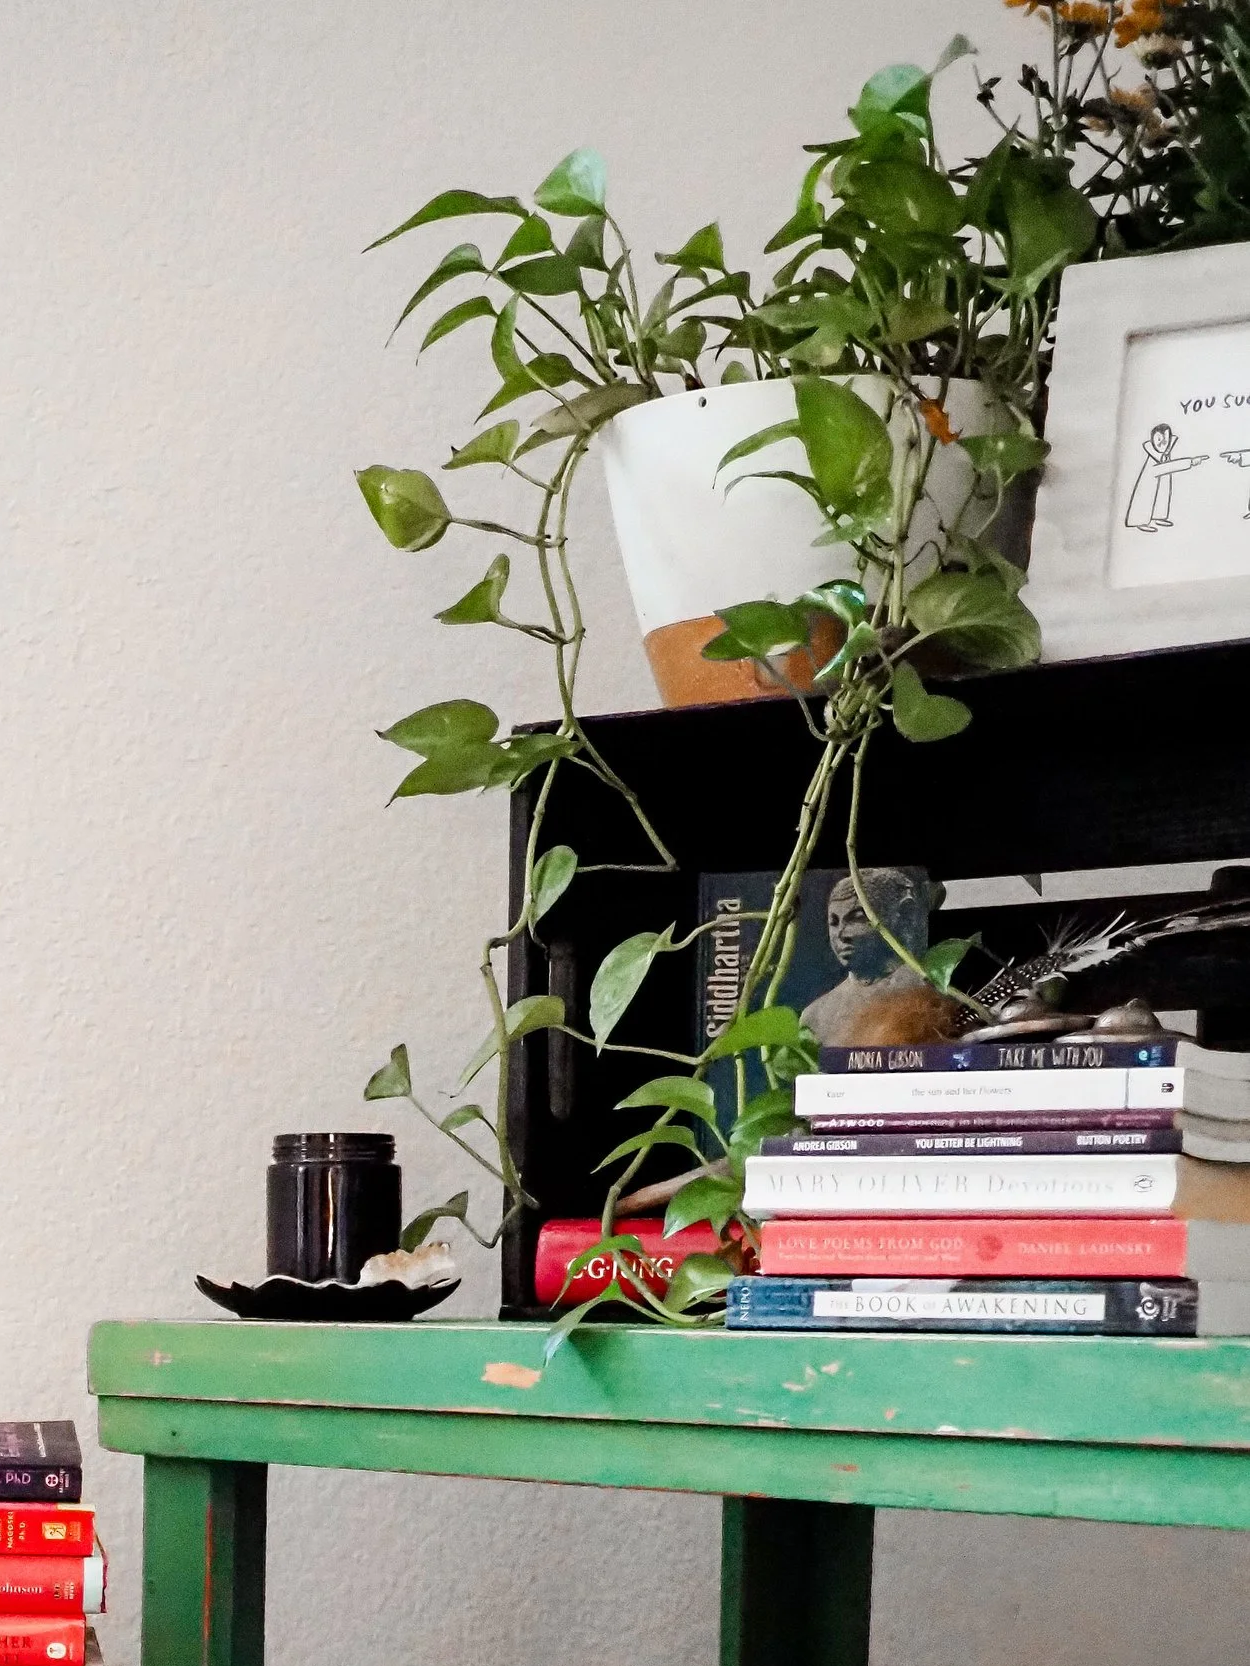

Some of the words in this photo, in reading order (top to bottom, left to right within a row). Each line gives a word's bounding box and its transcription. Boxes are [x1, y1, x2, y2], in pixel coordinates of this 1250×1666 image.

[1180, 396, 1216, 415] YOU
[847, 1050, 882, 1070] ANDREA
[888, 1049, 924, 1069] GIBSON
[998, 1047, 1026, 1068] TAKE
[1031, 1047, 1045, 1068] ME
[1051, 1046, 1079, 1066] WITH
[1082, 1046, 1103, 1067] YOU
[793, 1140, 825, 1151] ANDREA
[826, 1139, 857, 1151] GIBSON
[915, 1138, 933, 1149] YOU
[934, 1137, 963, 1149] BETTER
[964, 1137, 974, 1148] BE
[976, 1135, 1023, 1147] LIGHTNING
[1076, 1135, 1111, 1146] BUTTON
[1112, 1134, 1147, 1145] POETRY
[769, 1174, 839, 1193] MARY
[858, 1174, 968, 1193] OLIVER
[988, 1174, 1115, 1193] Devotions
[778, 1238, 817, 1250] LOVE
[822, 1238, 874, 1250] POEMS
[879, 1238, 924, 1250] FROM
[929, 1237, 963, 1250] GOD
[1019, 1242, 1071, 1254] DANIEL
[854, 1296, 917, 1313] BOOK
[941, 1297, 1088, 1315] AWAKENING
[6, 1473, 31, 1485] PhD
